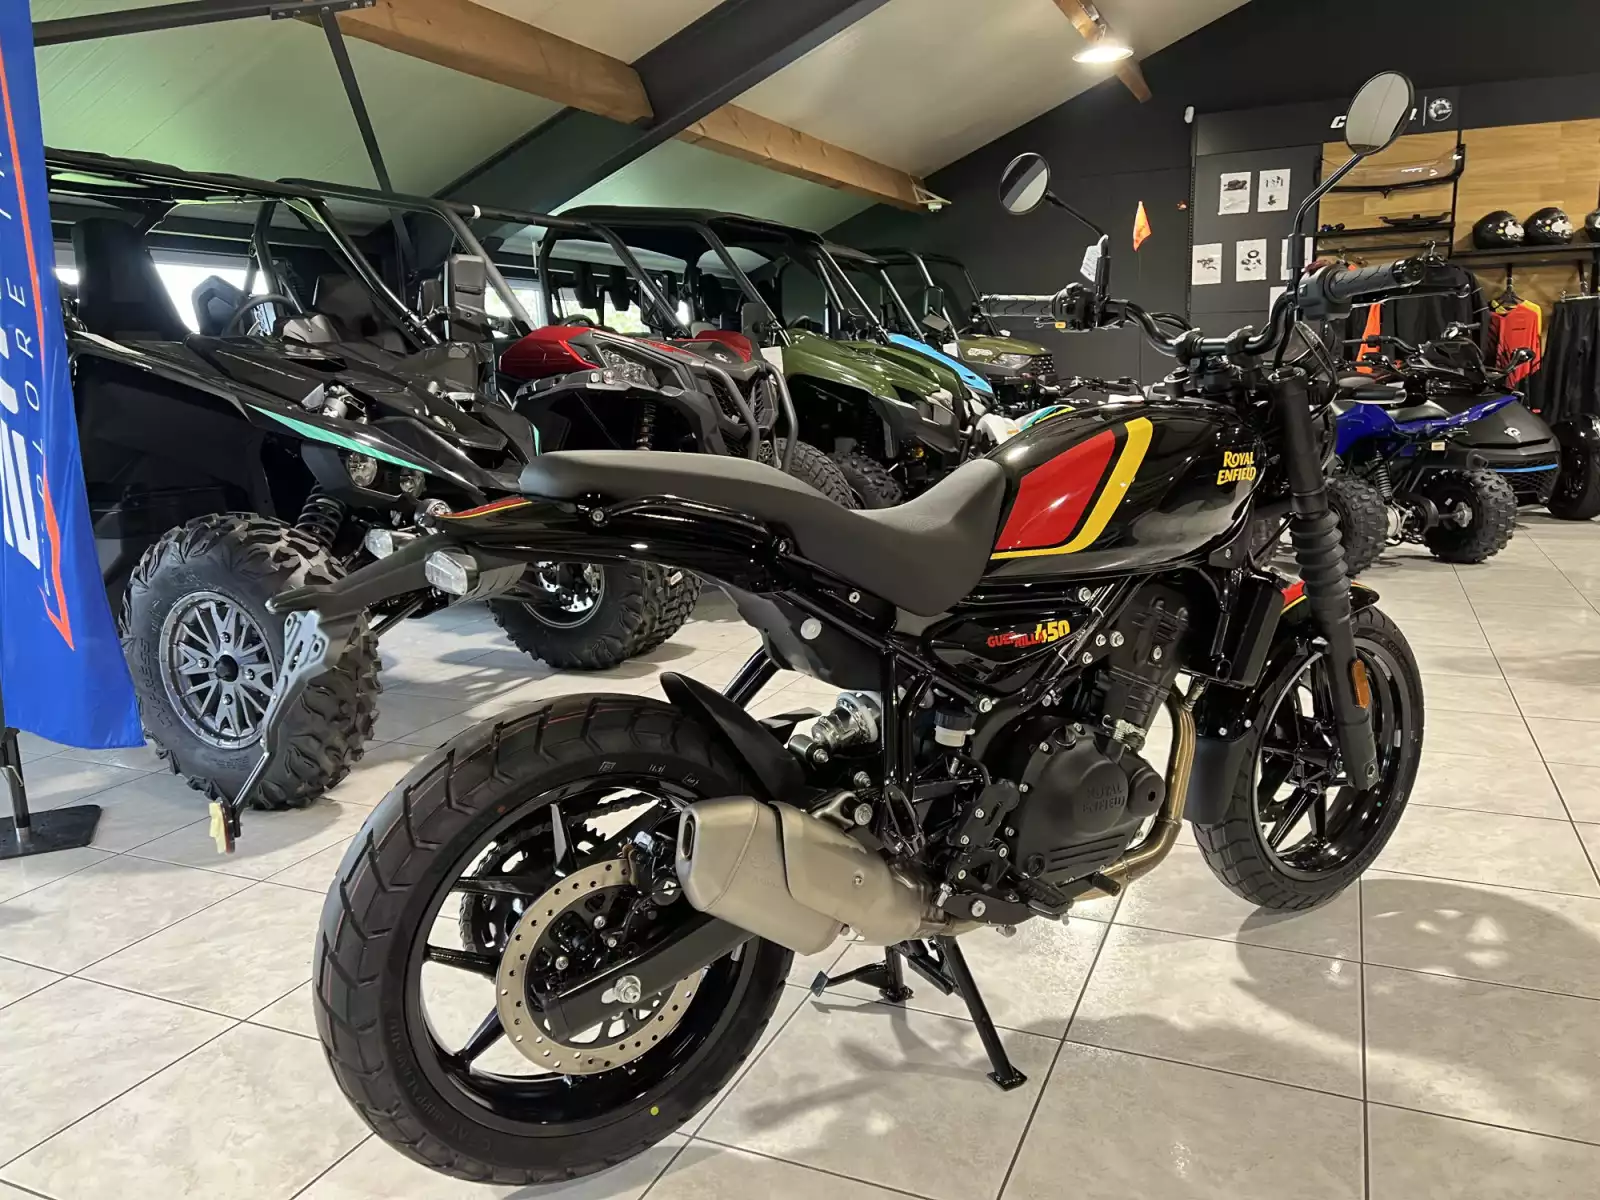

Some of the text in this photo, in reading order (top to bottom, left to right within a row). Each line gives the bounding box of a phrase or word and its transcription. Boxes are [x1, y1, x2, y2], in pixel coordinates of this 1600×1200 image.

[1223, 451, 1255, 468] ROYAL
[1216, 466, 1257, 485] ENFIELD
[1035, 619, 1071, 643] 450
